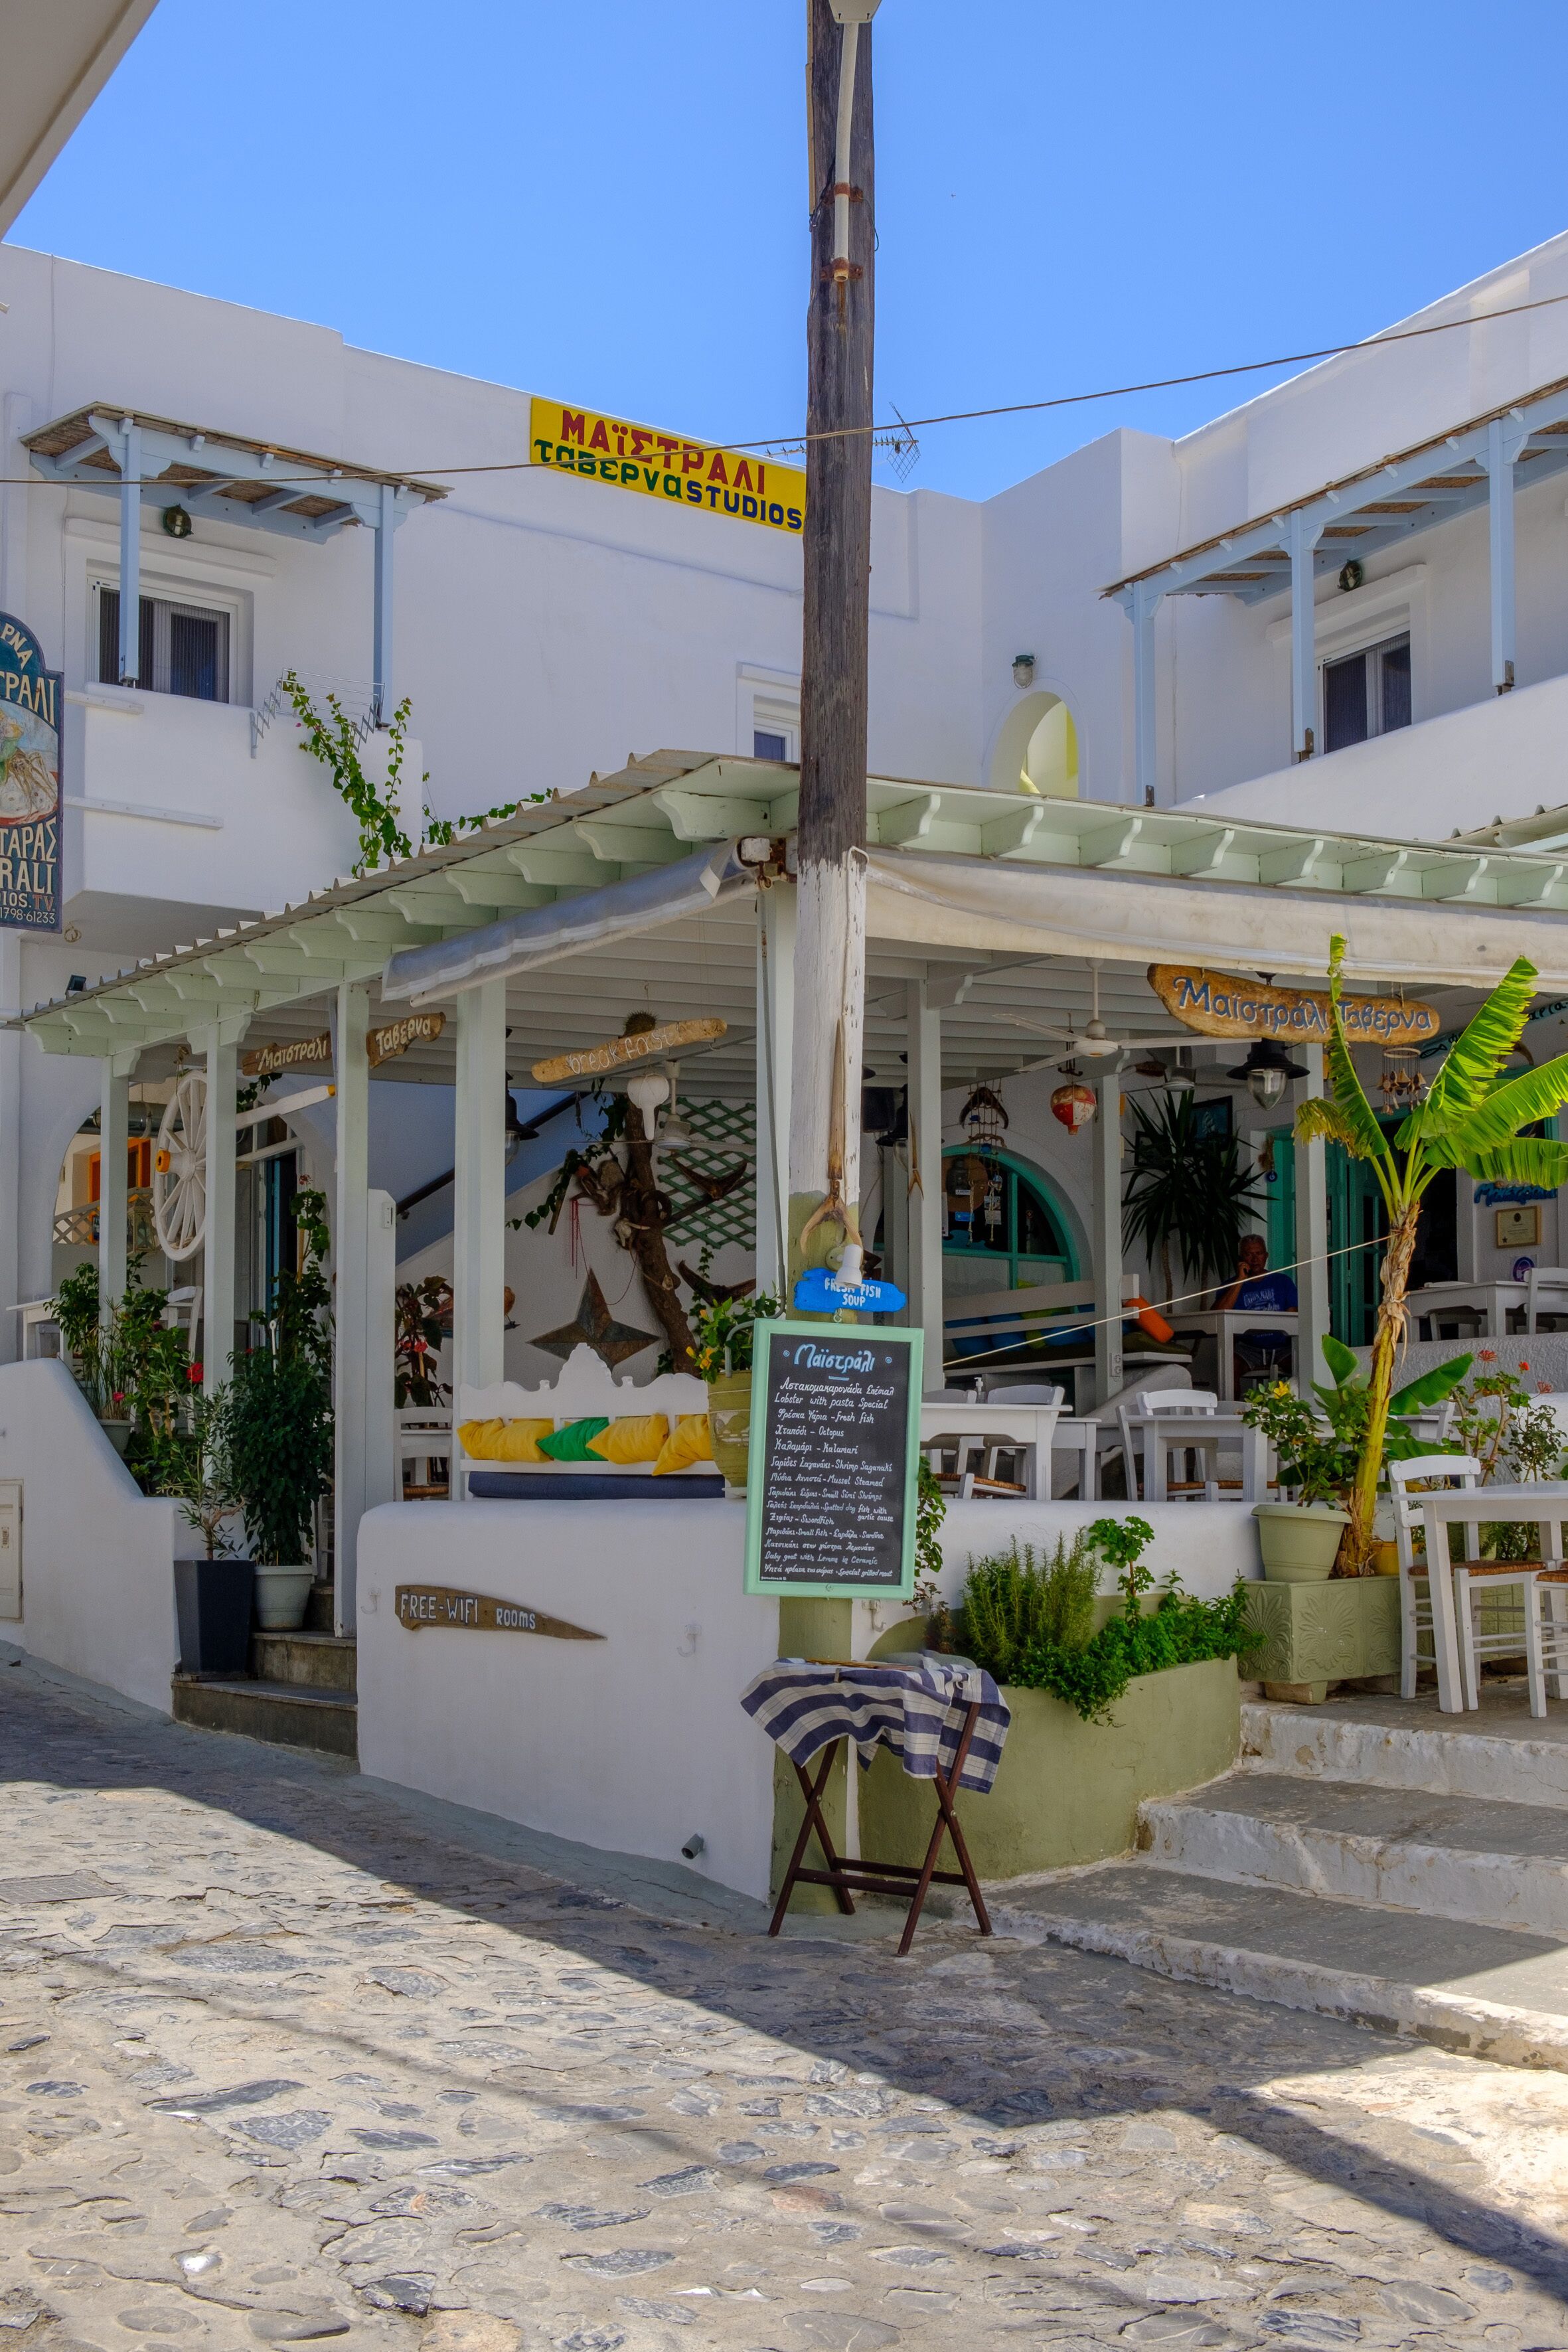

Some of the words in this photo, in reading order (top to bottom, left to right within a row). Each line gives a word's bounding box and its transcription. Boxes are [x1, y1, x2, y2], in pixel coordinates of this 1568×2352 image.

[686, 481, 803, 530] STUDIOS
[1336, 1000, 1433, 1038] Ταβέρνα
[375, 1018, 431, 1056] Ταβέρνα
[860, 1283, 882, 1298] FISH
[842, 1293, 866, 1307] SOUP
[774, 1392, 803, 1403] Lobster
[809, 1395, 827, 1405] with
[828, 1398, 854, 1409] pasta
[858, 1397, 889, 1409] Special
[858, 1412, 874, 1424] fish
[819, 1426, 844, 1439] Octopus
[823, 1443, 858, 1454] Kalamari
[860, 1460, 893, 1474] Saganaki
[854, 1476, 885, 1487] Steamed
[858, 1490, 882, 1502] Shrimps
[846, 1504, 856, 1514] dog
[858, 1504, 870, 1514] fish
[801, 1514, 834, 1525] Swordfish
[857, 1513, 874, 1522] garlic
[764, 1551, 781, 1561] Baby
[783, 1553, 797, 1561] goat
[851, 1556, 878, 1565] Ceramic
